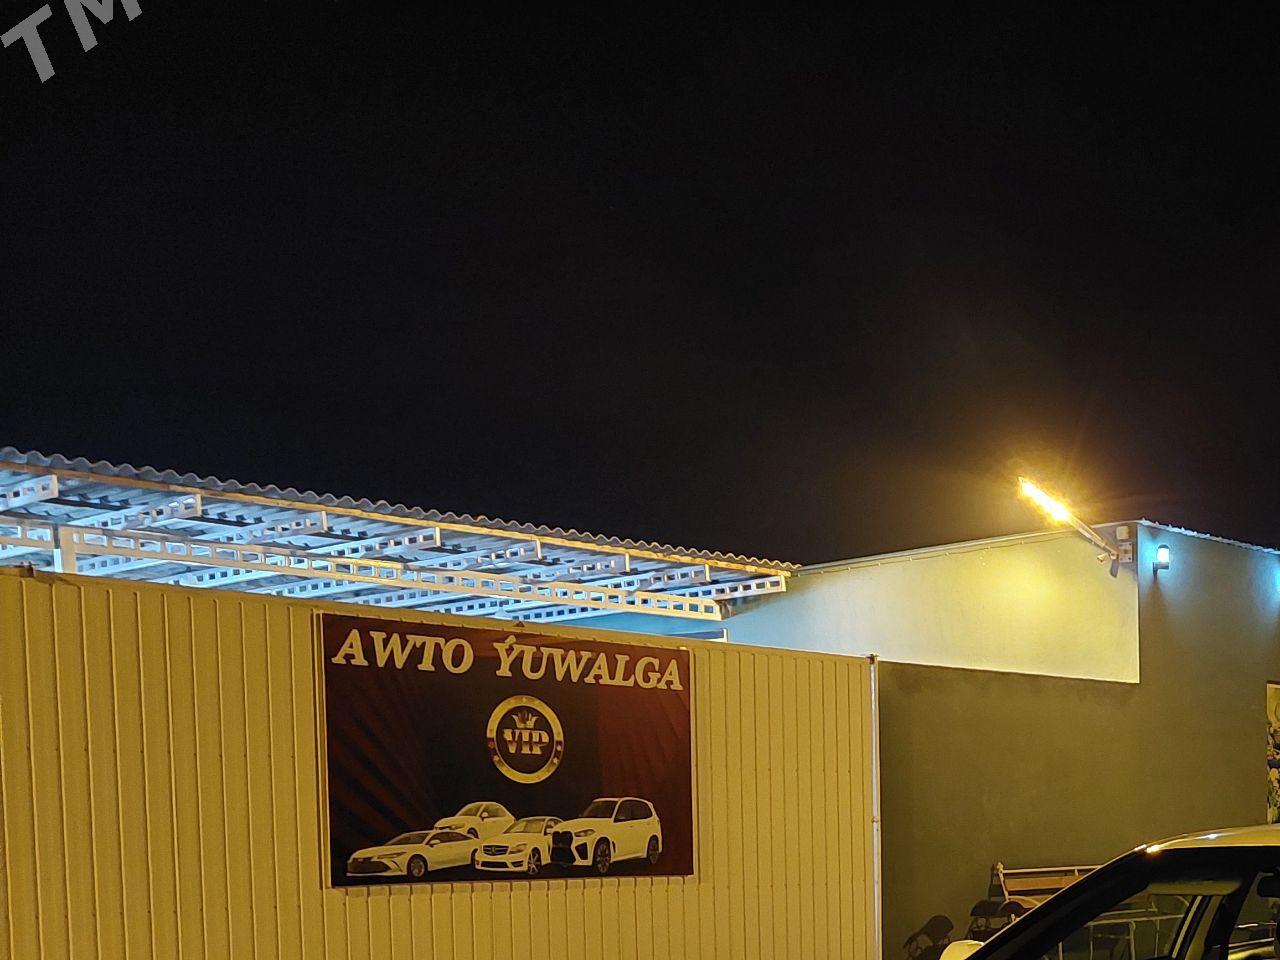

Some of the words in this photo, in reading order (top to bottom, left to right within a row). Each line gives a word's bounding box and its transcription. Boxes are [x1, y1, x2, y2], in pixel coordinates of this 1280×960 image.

[331, 629, 474, 674] AWTO
[493, 635, 683, 690] ÝUWALGA
[503, 728, 549, 754] VIP
